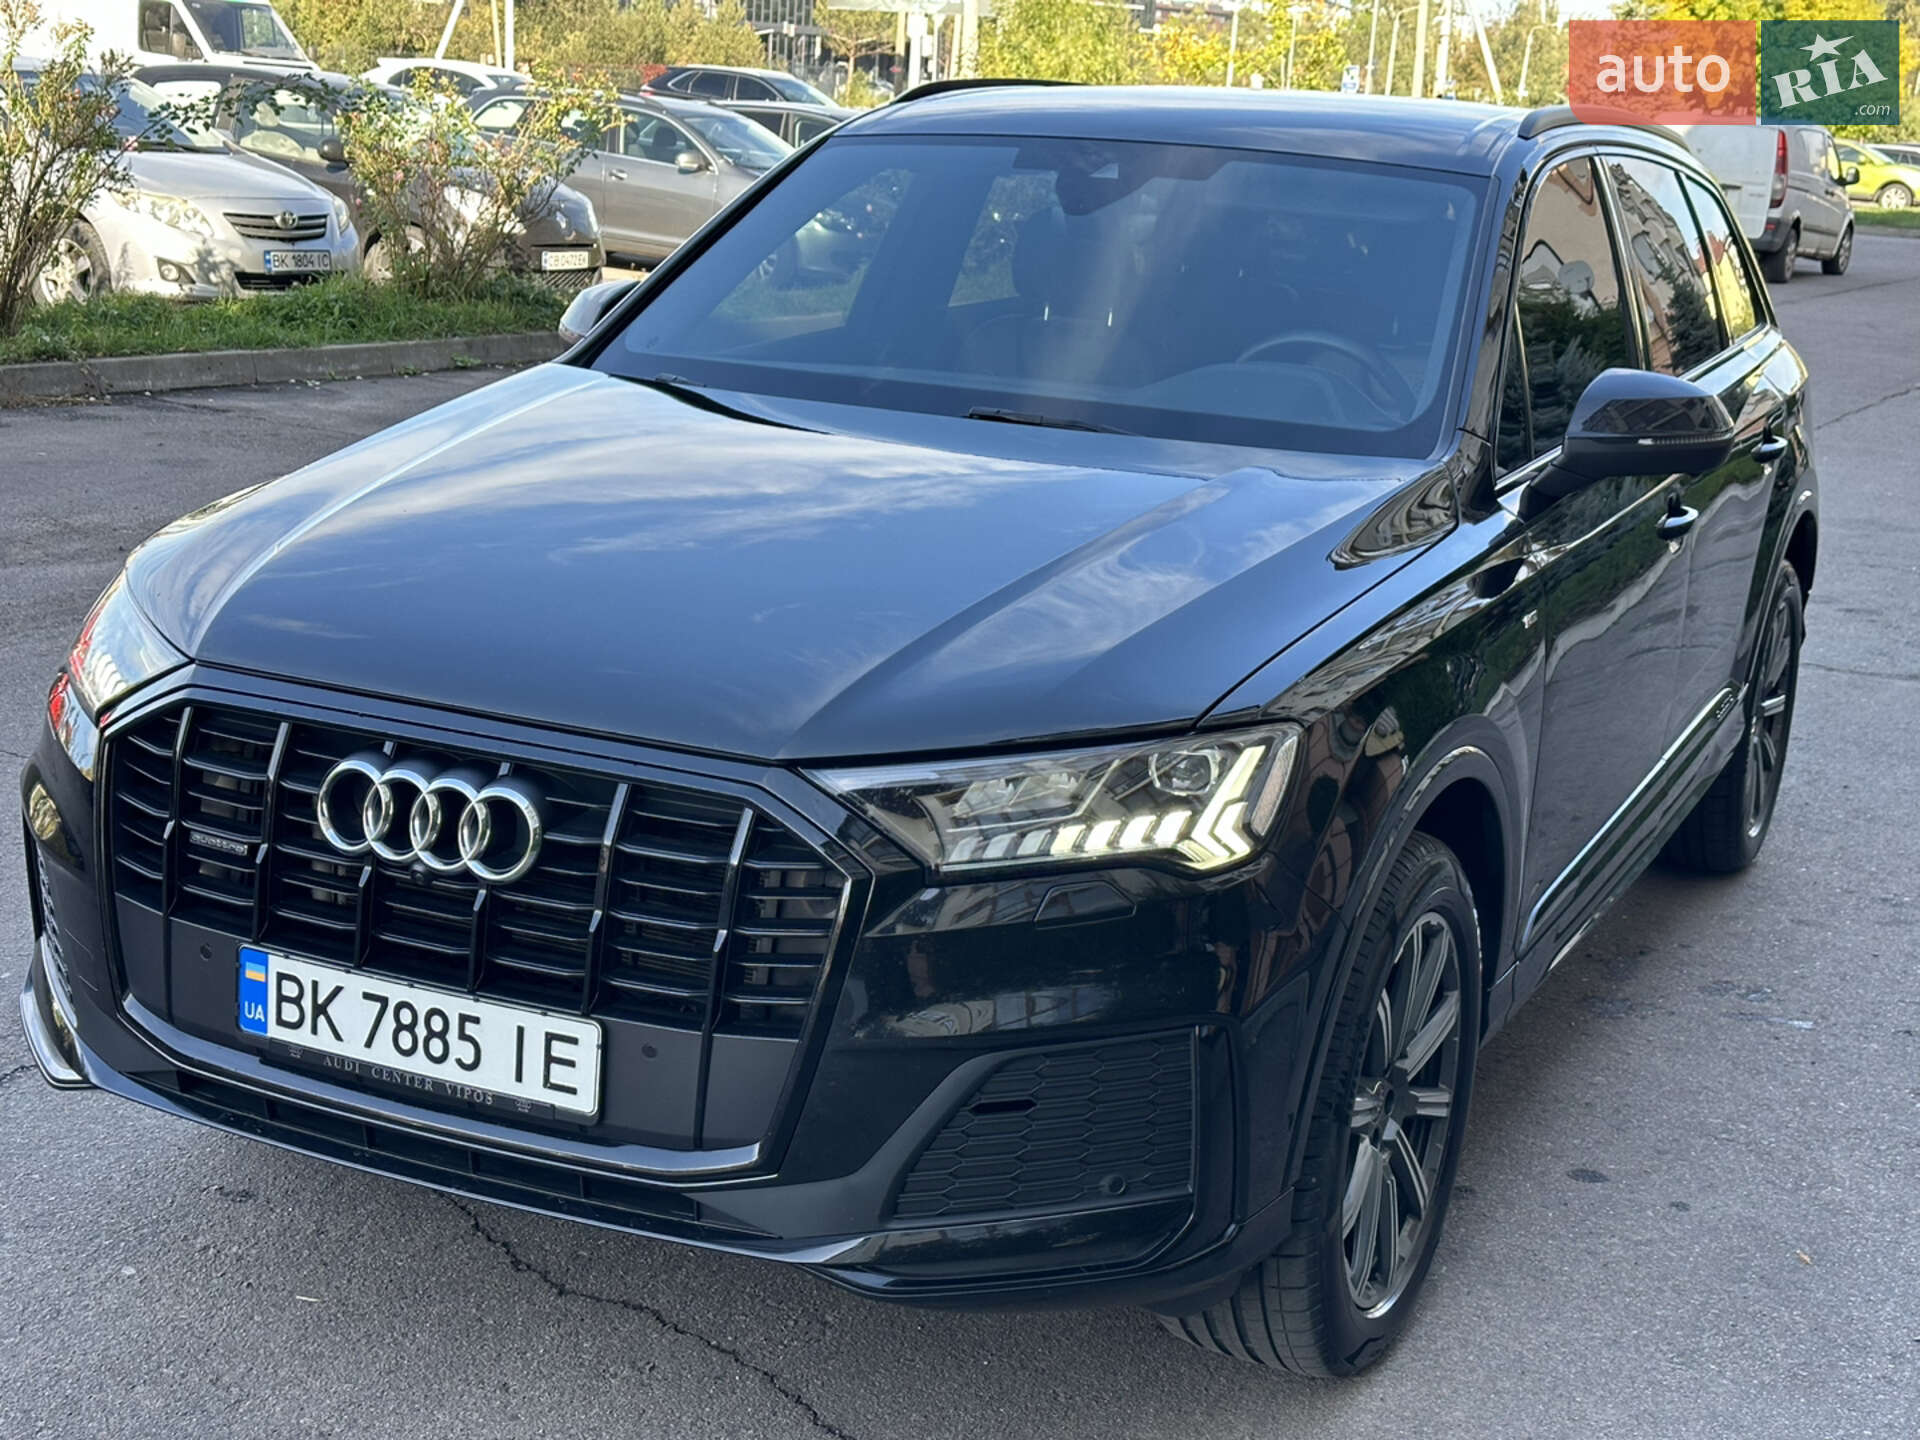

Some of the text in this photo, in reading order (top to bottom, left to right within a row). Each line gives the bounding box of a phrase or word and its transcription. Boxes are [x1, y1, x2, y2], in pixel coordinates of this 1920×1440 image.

[272, 254, 289, 269] BK
[317, 254, 329, 268] IC
[244, 1001, 265, 1022] UA
[275, 971, 580, 1096] BK 7885 IE
[323, 1055, 494, 1105] AUDI CENTER VIPOS
